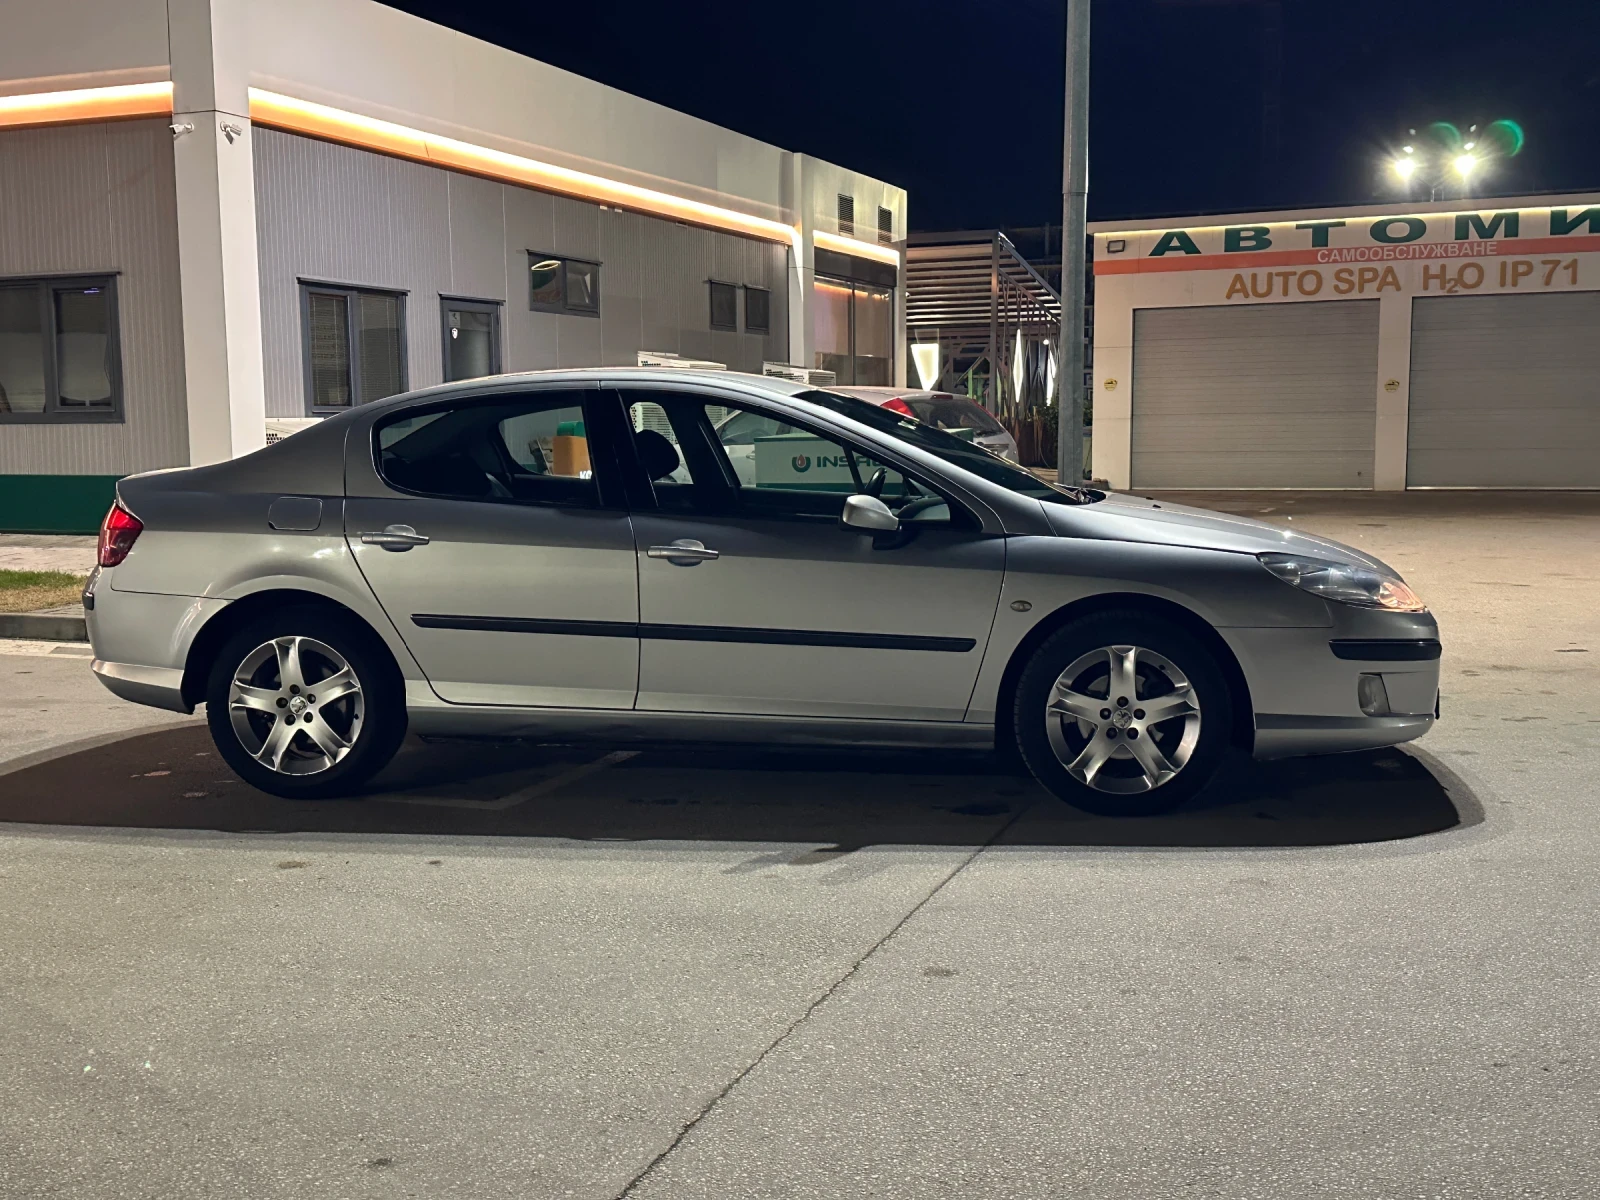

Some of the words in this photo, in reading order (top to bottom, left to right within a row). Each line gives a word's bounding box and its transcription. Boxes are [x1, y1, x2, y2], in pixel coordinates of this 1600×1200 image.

[1149, 207, 1600, 256] АВТОМИ
[1317, 241, 1498, 263] САМООБСЛУЖВАНЕ
[1225, 269, 1323, 299] AUTO
[1333, 265, 1402, 295] SPA
[1499, 260, 1534, 287] IP
[1540, 258, 1578, 286] 71
